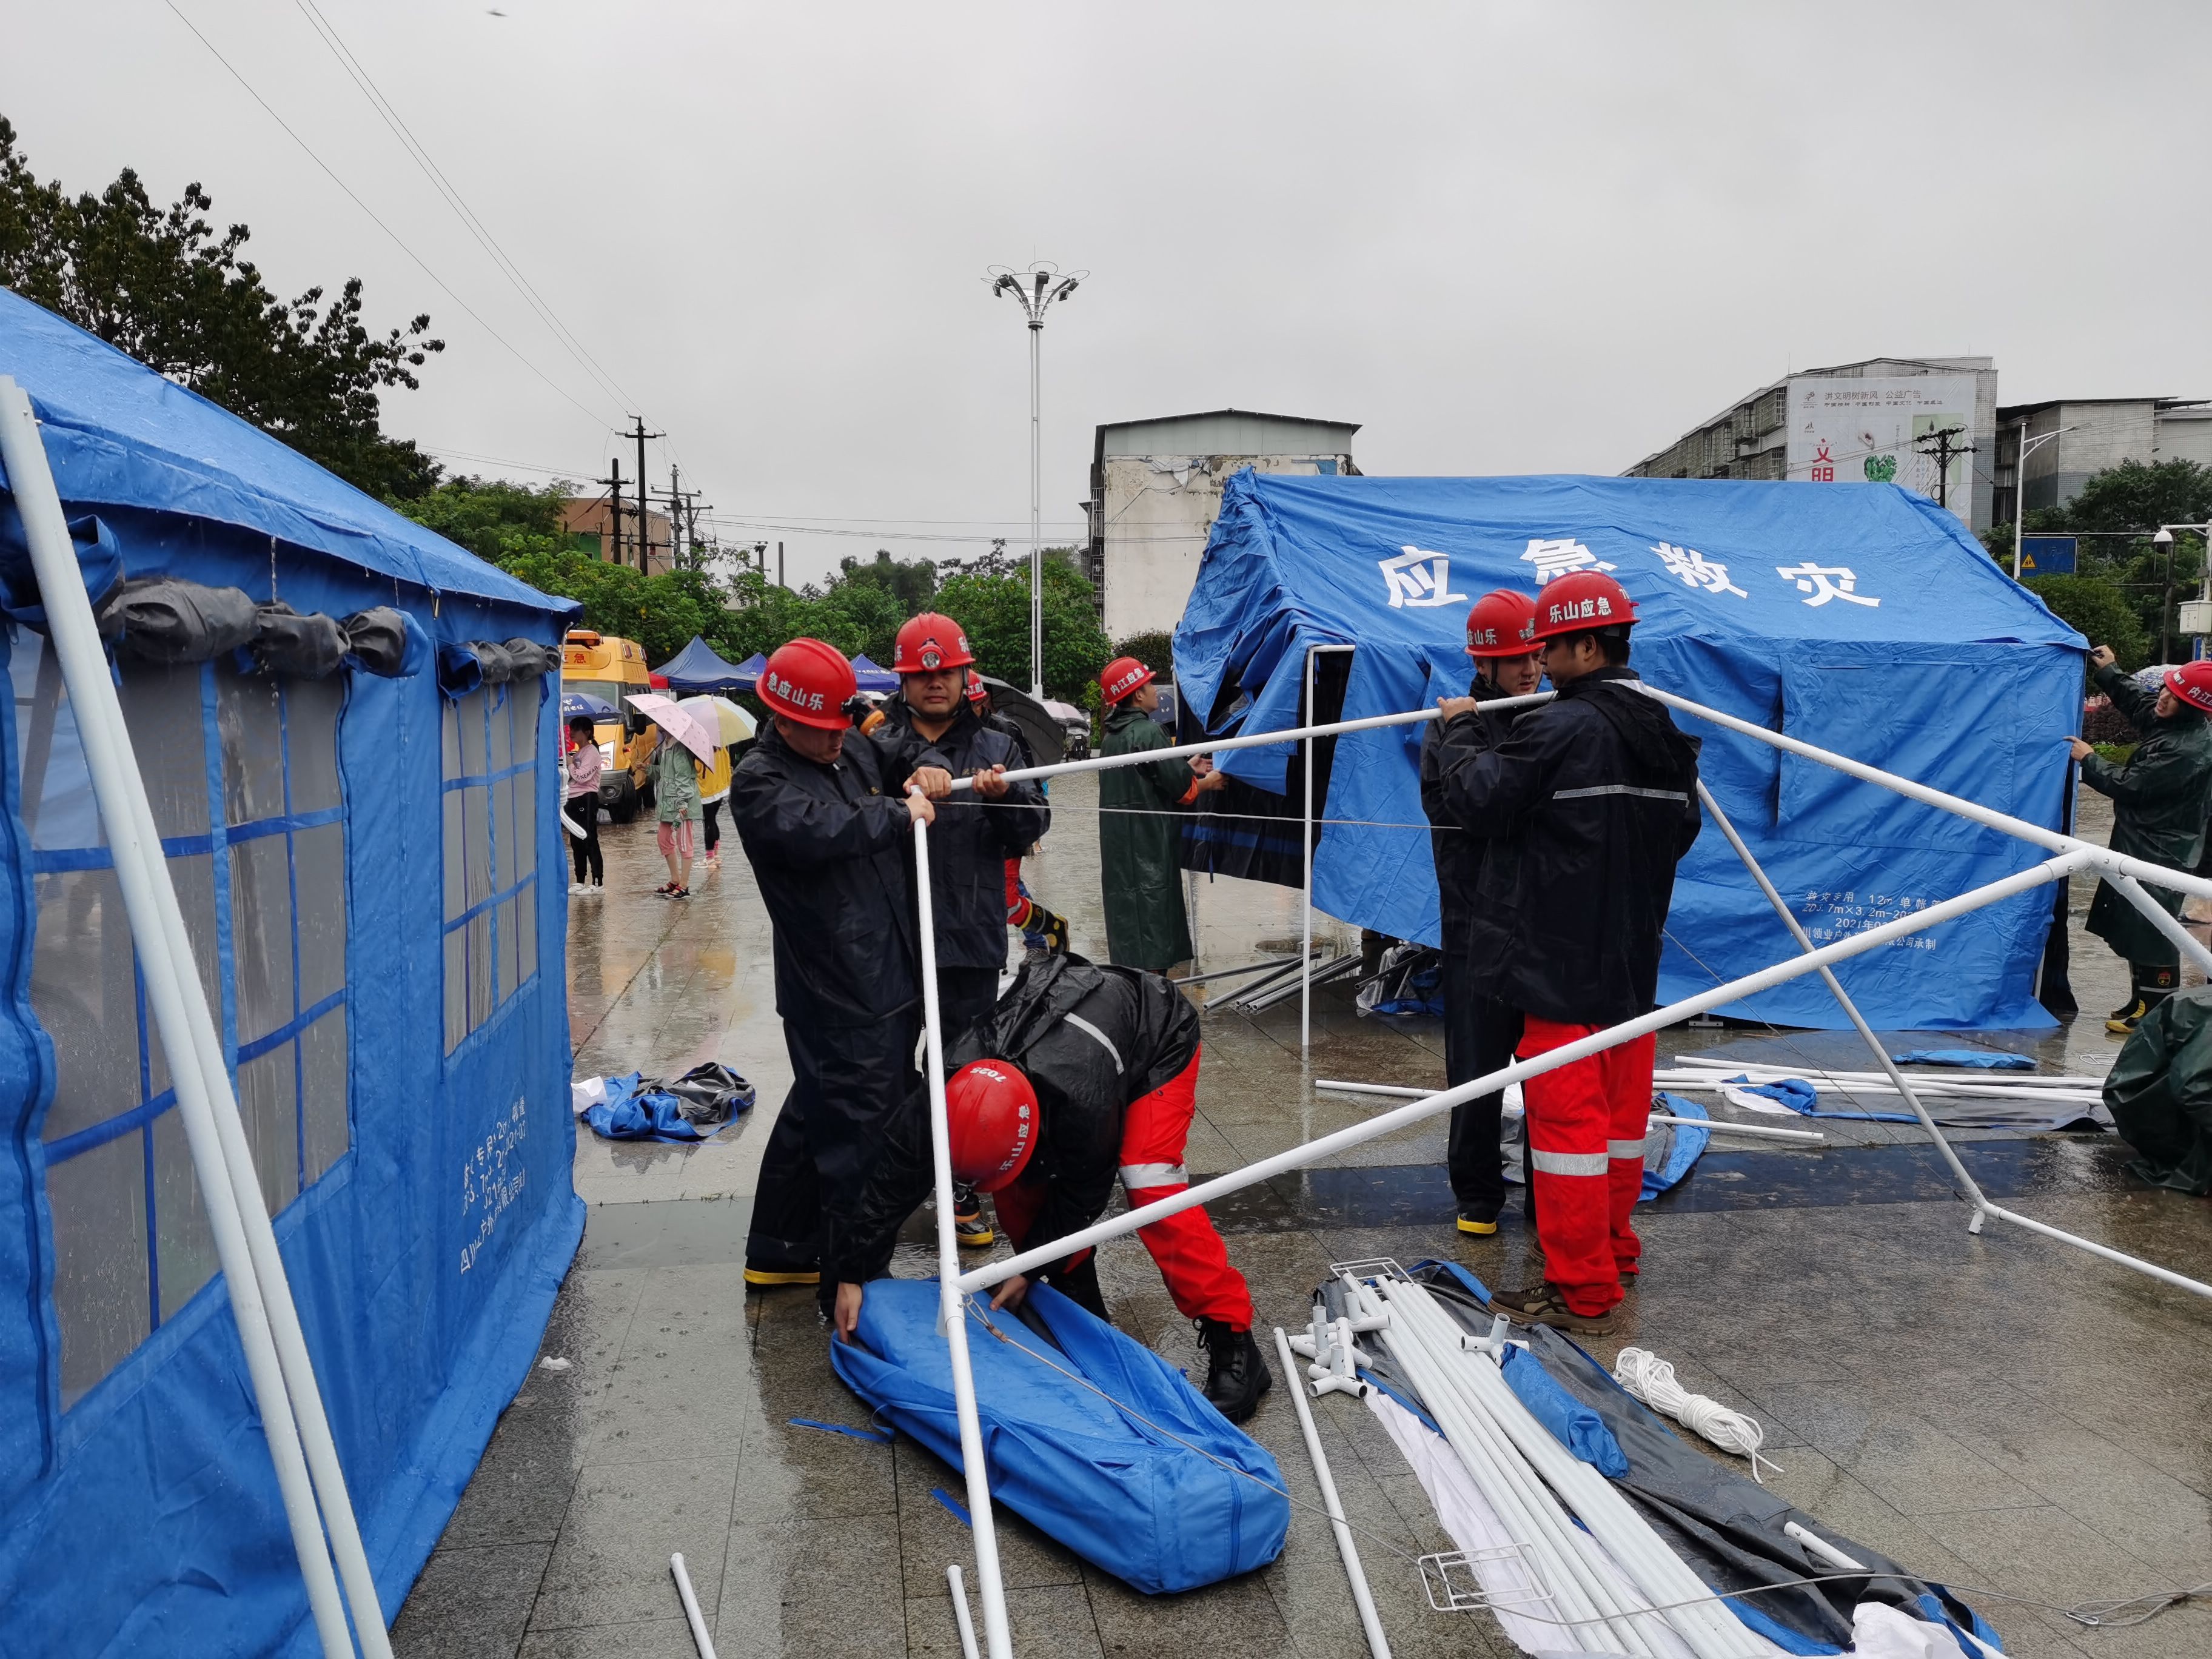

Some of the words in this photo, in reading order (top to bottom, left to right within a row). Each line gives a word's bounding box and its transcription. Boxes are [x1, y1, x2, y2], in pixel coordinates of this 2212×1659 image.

[1825, 391, 1878, 401] 讲文明树新风
[1885, 390, 1922, 398] 公益广告
[1549, 597, 1612, 623] 乐山应急
[1110, 667, 1145, 696] 内江应急
[1805, 890, 1854, 902] 救灾专用
[970, 1067, 1007, 1082] 7025
